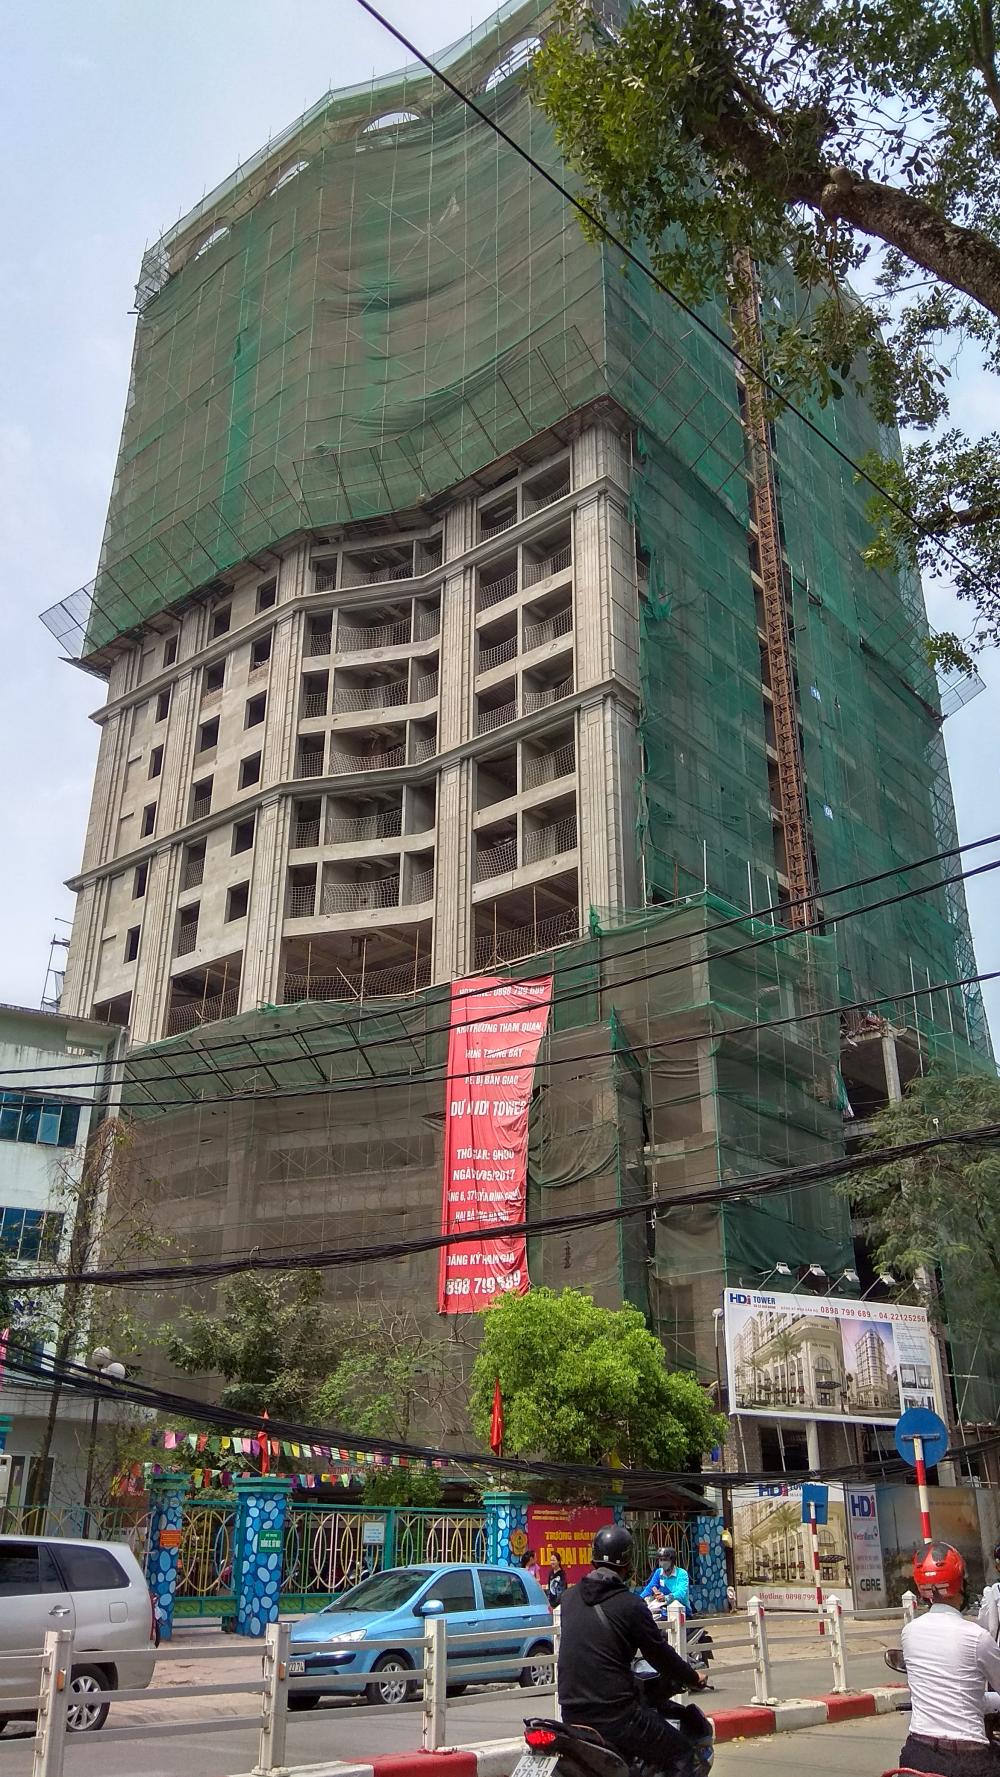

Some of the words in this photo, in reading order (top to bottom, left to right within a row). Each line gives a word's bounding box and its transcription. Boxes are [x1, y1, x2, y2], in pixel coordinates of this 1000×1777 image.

[499, 1023, 520, 1033] THAM
[502, 1075, 519, 1085] GIAO
[451, 1098, 466, 1119] DỰ
[493, 1100, 527, 1117] TOWER
[493, 1149, 515, 1161] 9H00
[753, 1295, 776, 1305] TOWER
[820, 1306, 839, 1315] 0898
[841, 1308, 855, 1316] 799
[858, 1310, 871, 1318] 689
[860, 1578, 882, 1592] CBRE
